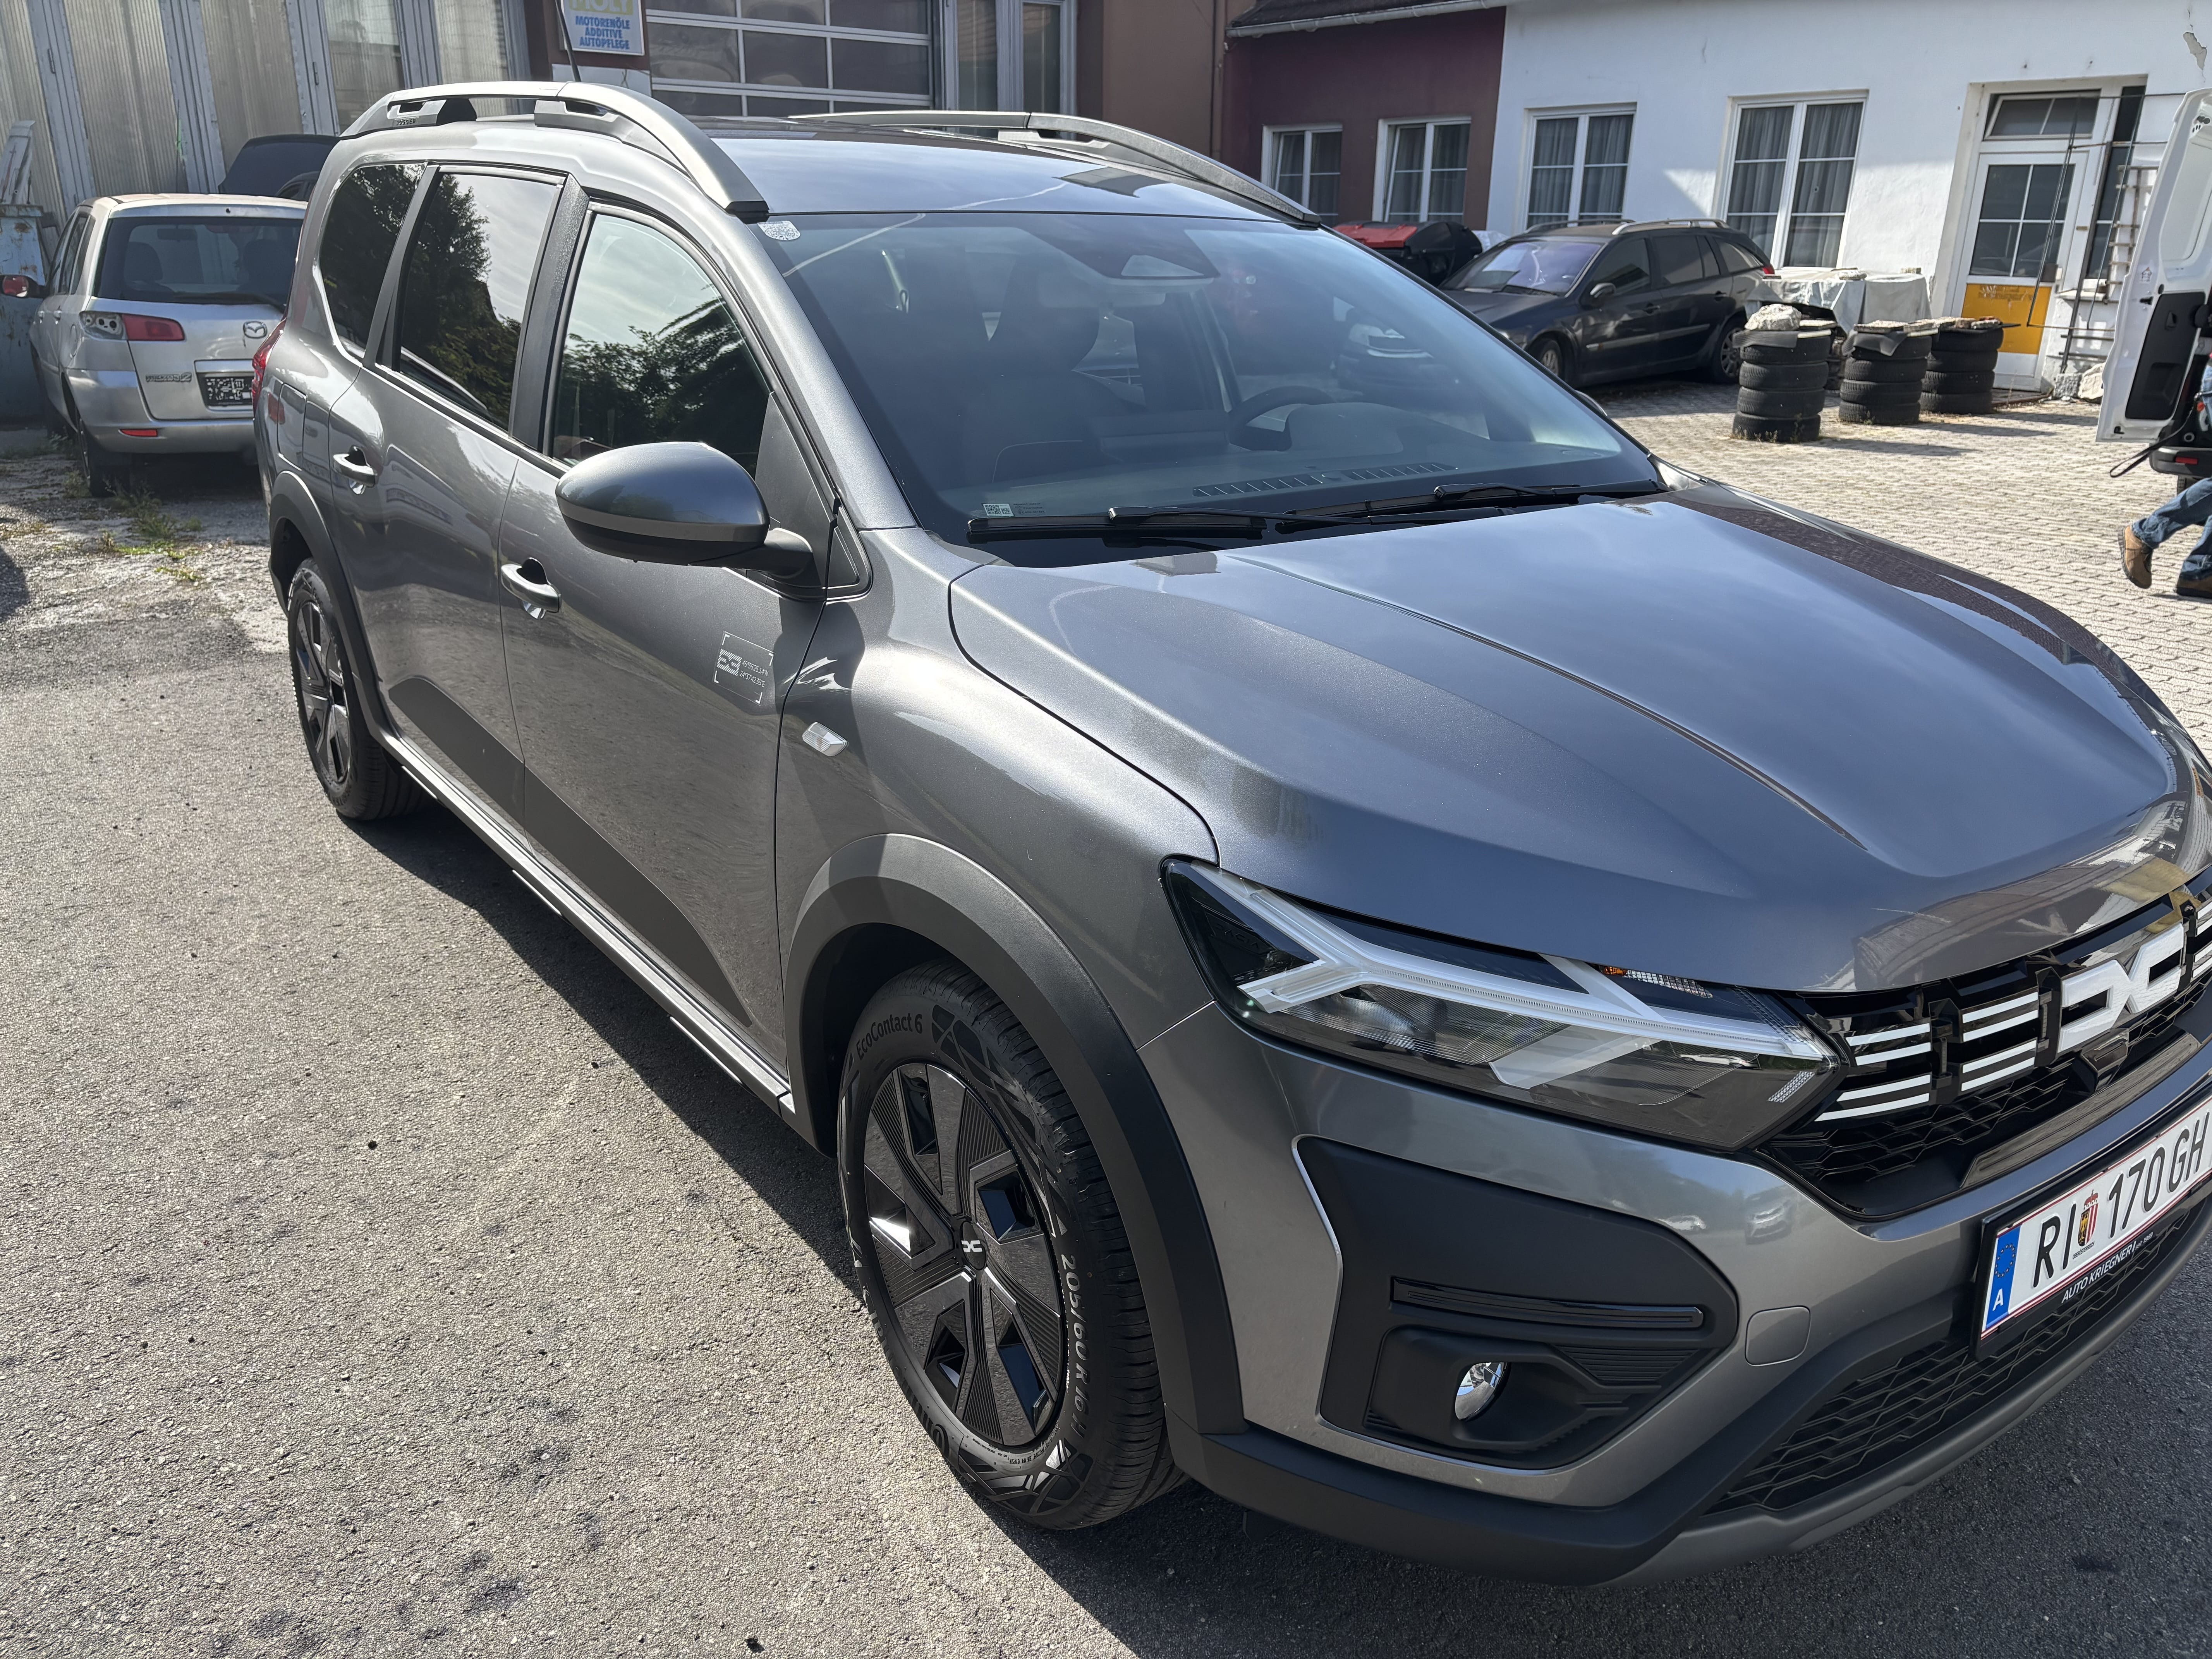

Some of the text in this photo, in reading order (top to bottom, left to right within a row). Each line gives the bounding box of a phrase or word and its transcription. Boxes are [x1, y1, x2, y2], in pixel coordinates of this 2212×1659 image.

[575, 15, 630, 29] MOTORENÖLE
[585, 27, 622, 38] ADDITIVE
[579, 37, 629, 49] AUTOPFLEGE
[856, 1013, 922, 1060] EcoContact 6
[2033, 1203, 2076, 1288] RI
[1992, 1288, 2004, 1311] A
[2061, 1276, 2088, 1304] AUTO
